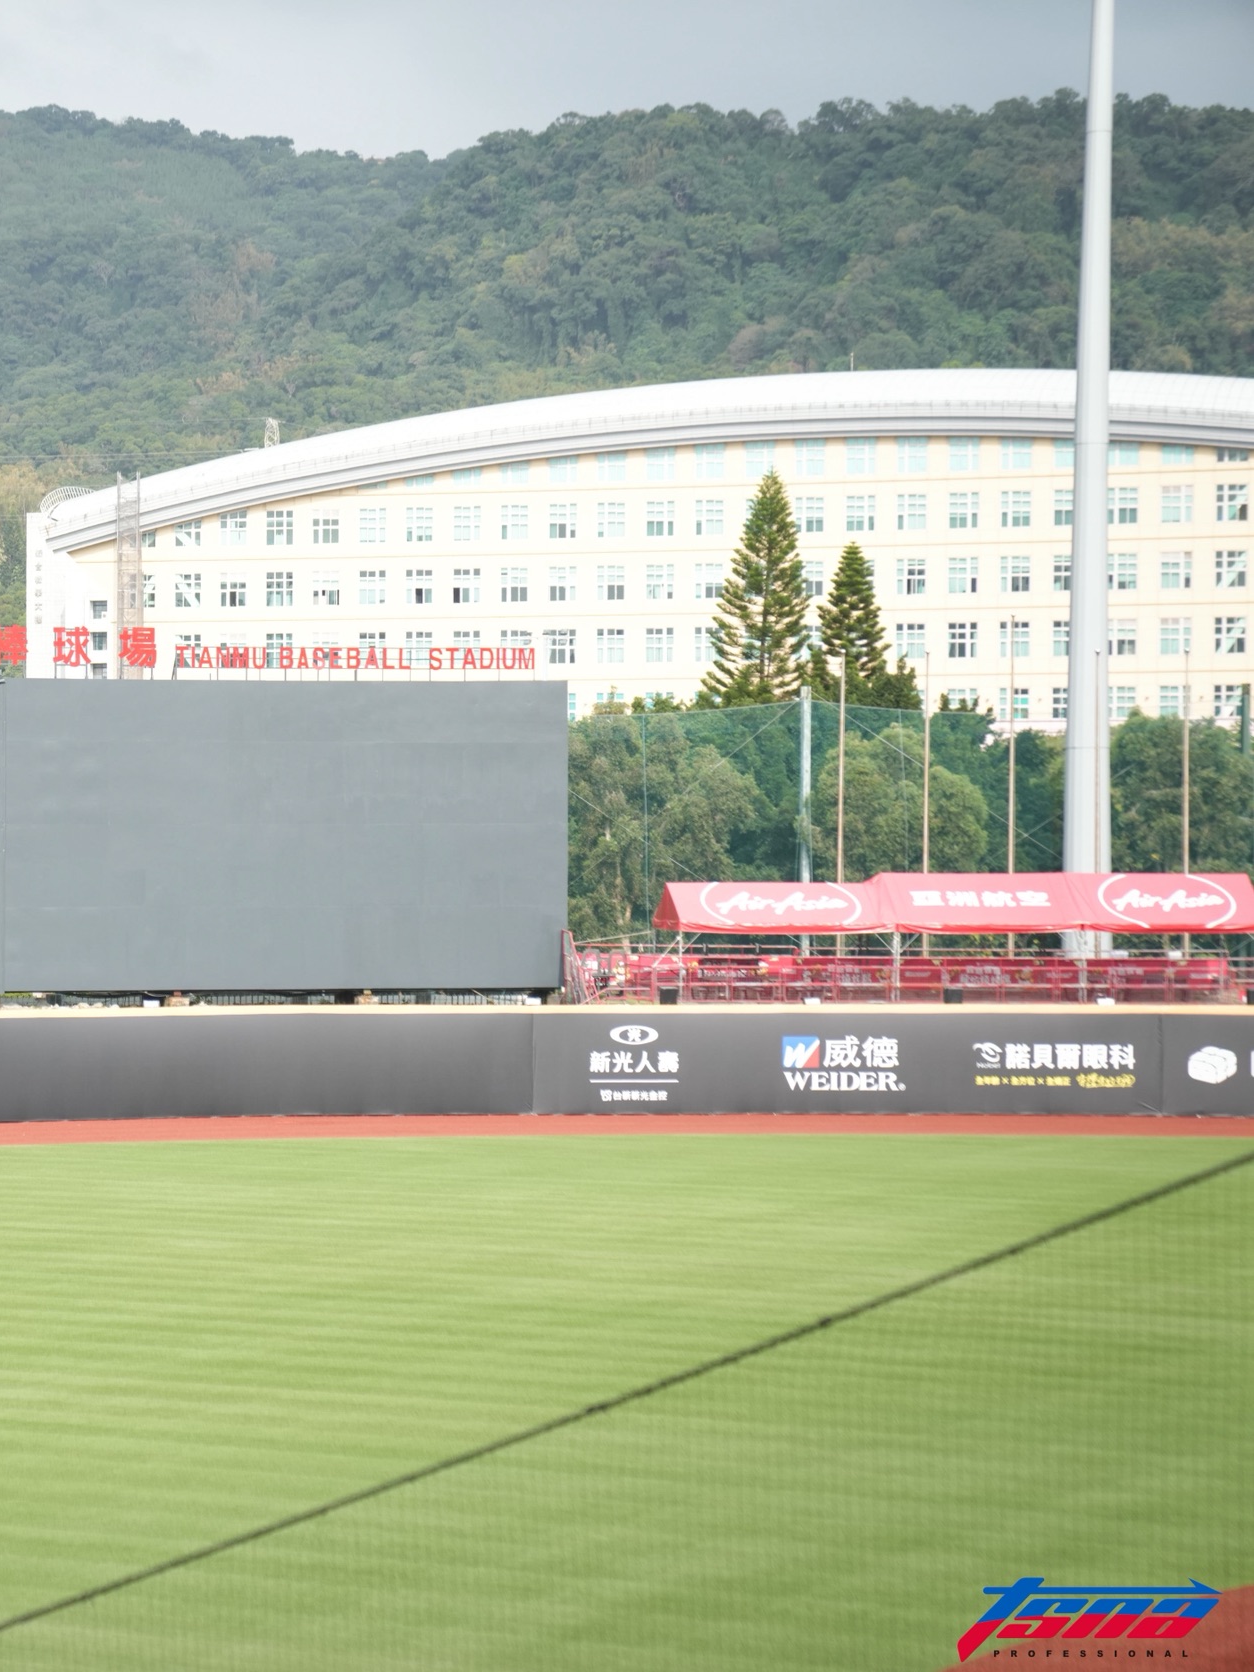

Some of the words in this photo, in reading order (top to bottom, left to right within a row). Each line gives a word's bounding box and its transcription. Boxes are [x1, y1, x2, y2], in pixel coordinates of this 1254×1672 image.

[175, 646, 267, 670] TIANMU
[279, 646, 411, 671] BASEBALL
[429, 647, 535, 671] STADIUM
[589, 1050, 680, 1073] 新光人壽
[823, 1035, 900, 1068] 威德
